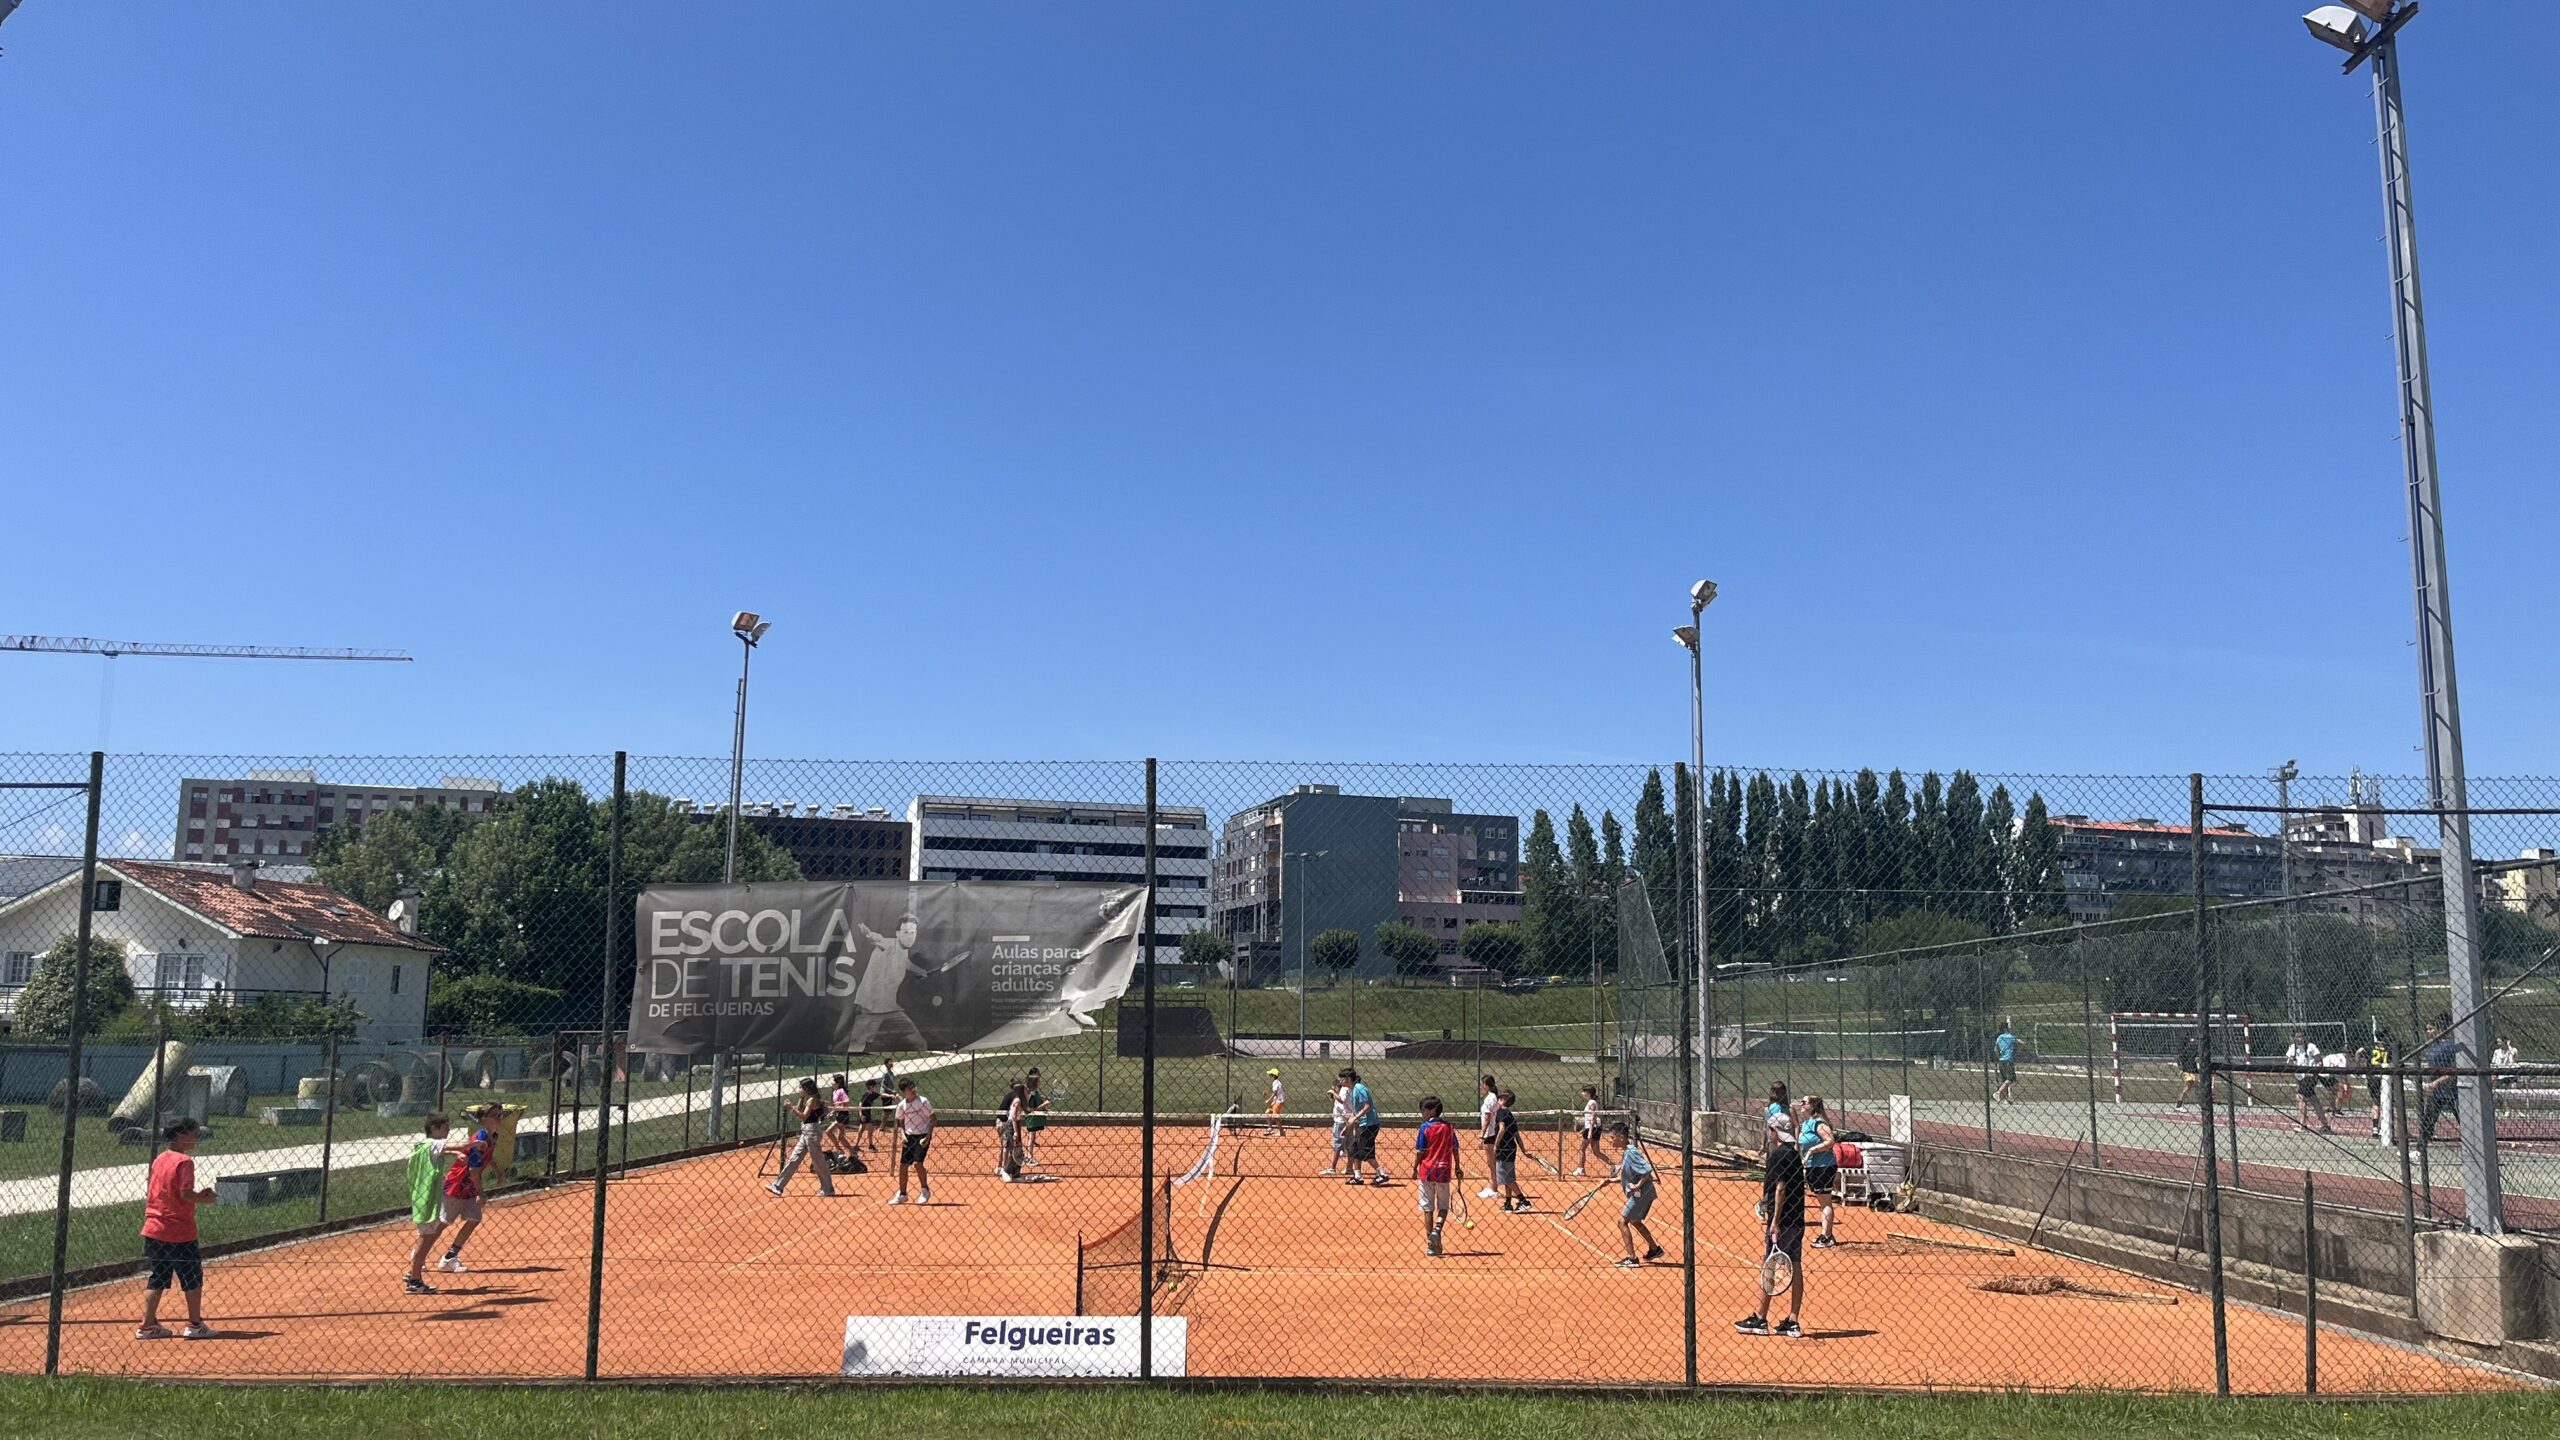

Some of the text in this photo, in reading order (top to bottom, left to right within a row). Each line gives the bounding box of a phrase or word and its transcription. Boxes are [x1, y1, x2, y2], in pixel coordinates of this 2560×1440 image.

[651, 908, 857, 956] ESCOLA
[991, 945, 1082, 963] Aulas para
[651, 957, 711, 1000] DE
[991, 961, 1062, 979] crianças
[991, 976, 1055, 993] adultos
[648, 1002, 775, 1018] DE FELGUEIRAS
[964, 1319, 1116, 1351] Felgueiras
[1010, 1356, 1066, 1365] MUNICIPAL
